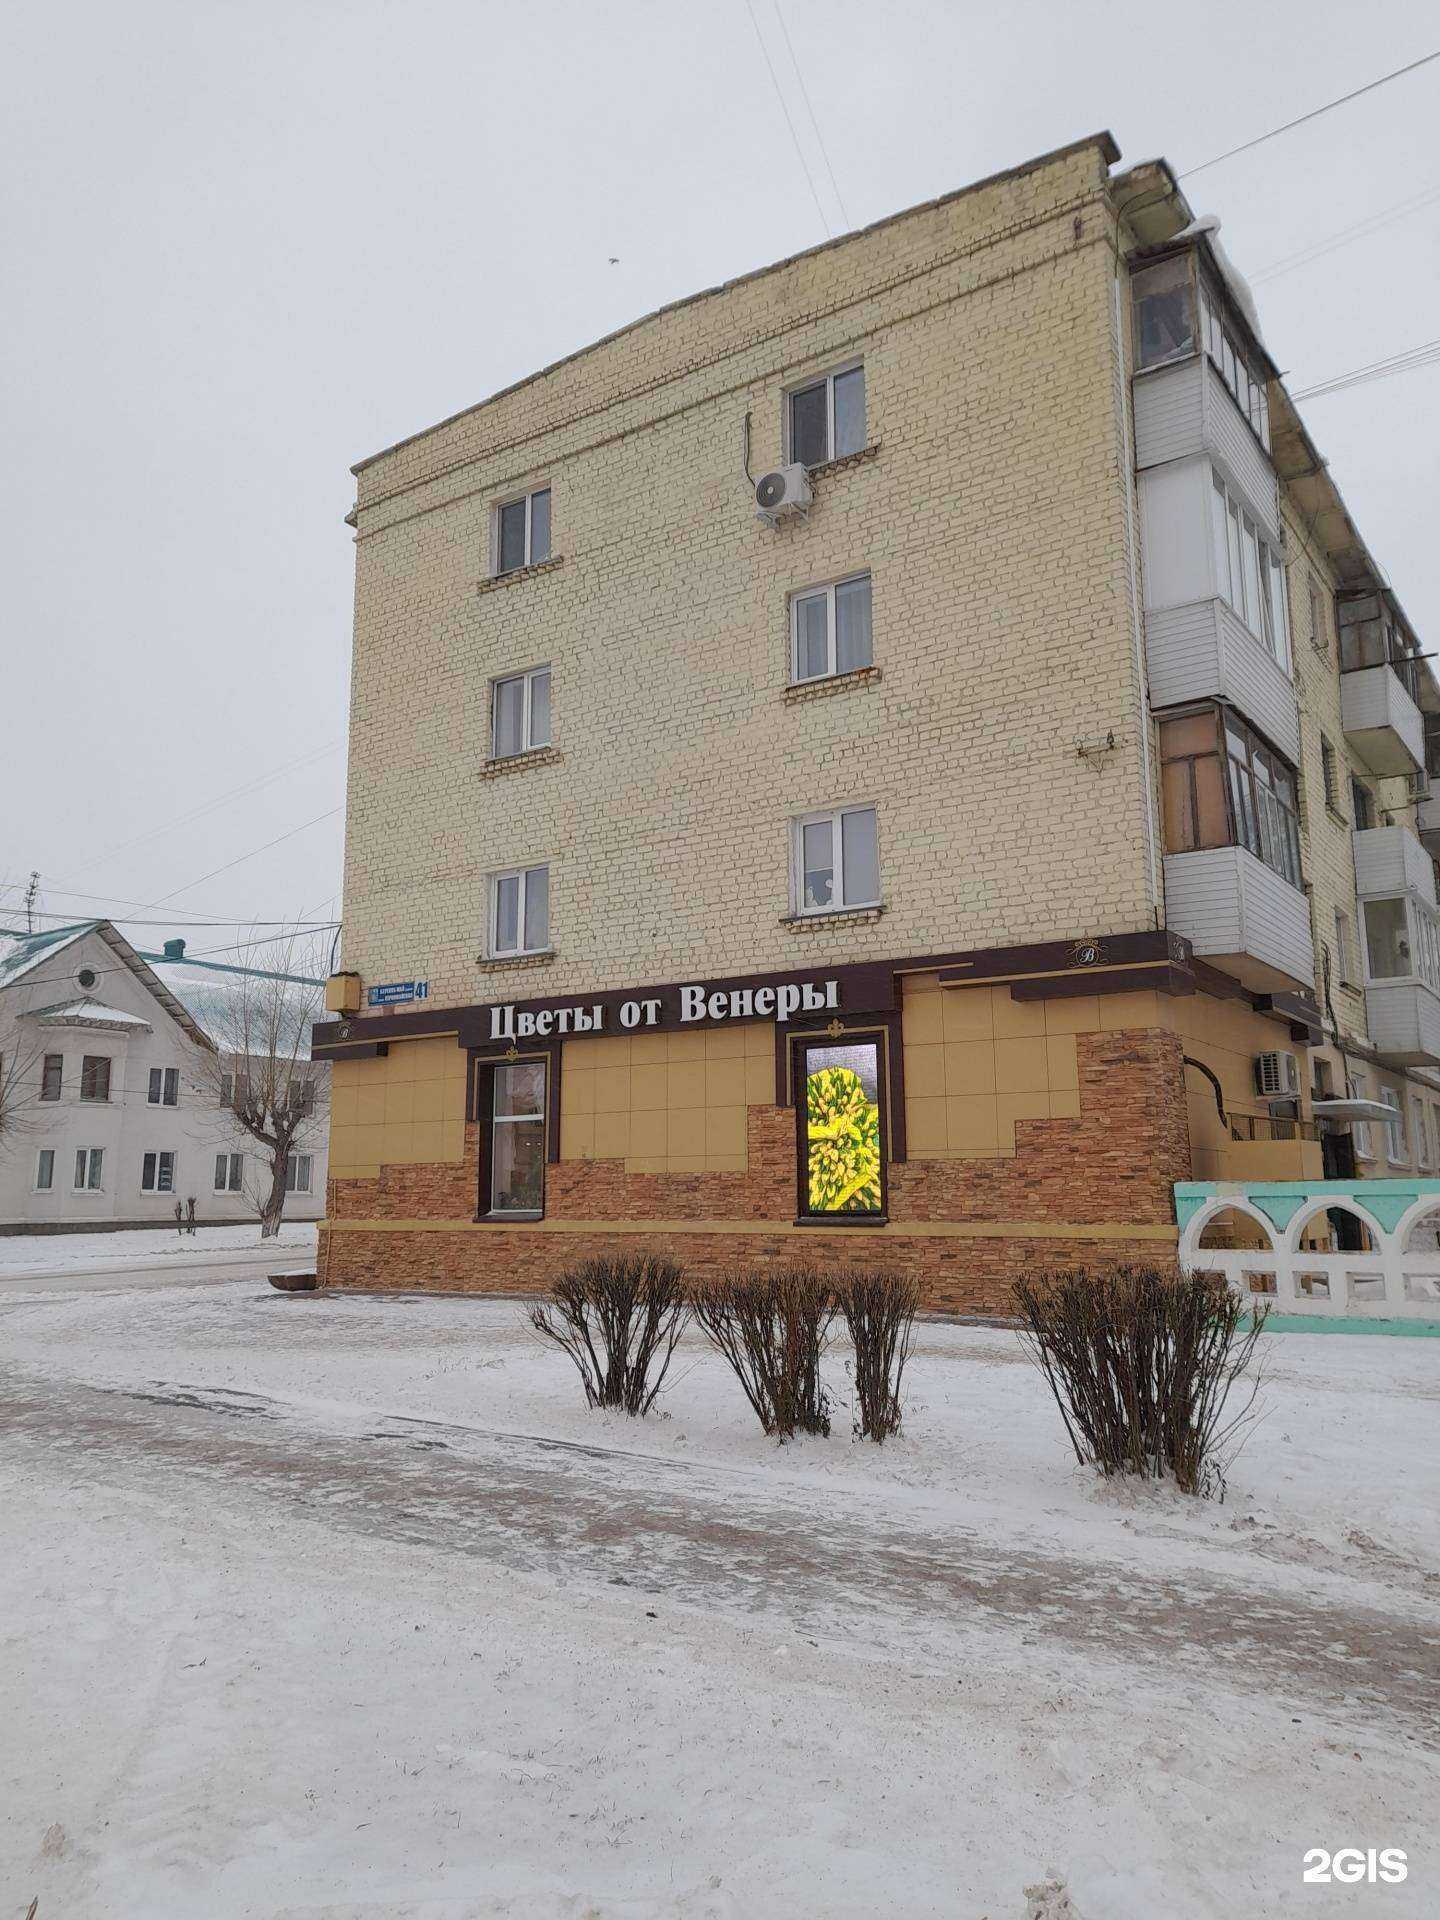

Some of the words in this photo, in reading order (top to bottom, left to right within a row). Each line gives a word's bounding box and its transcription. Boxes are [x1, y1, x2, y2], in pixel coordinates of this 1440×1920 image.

[414, 982, 428, 999] 41
[489, 1004, 604, 1046] Цветы
[620, 999, 662, 1027] от
[679, 981, 839, 1022] Венеры
